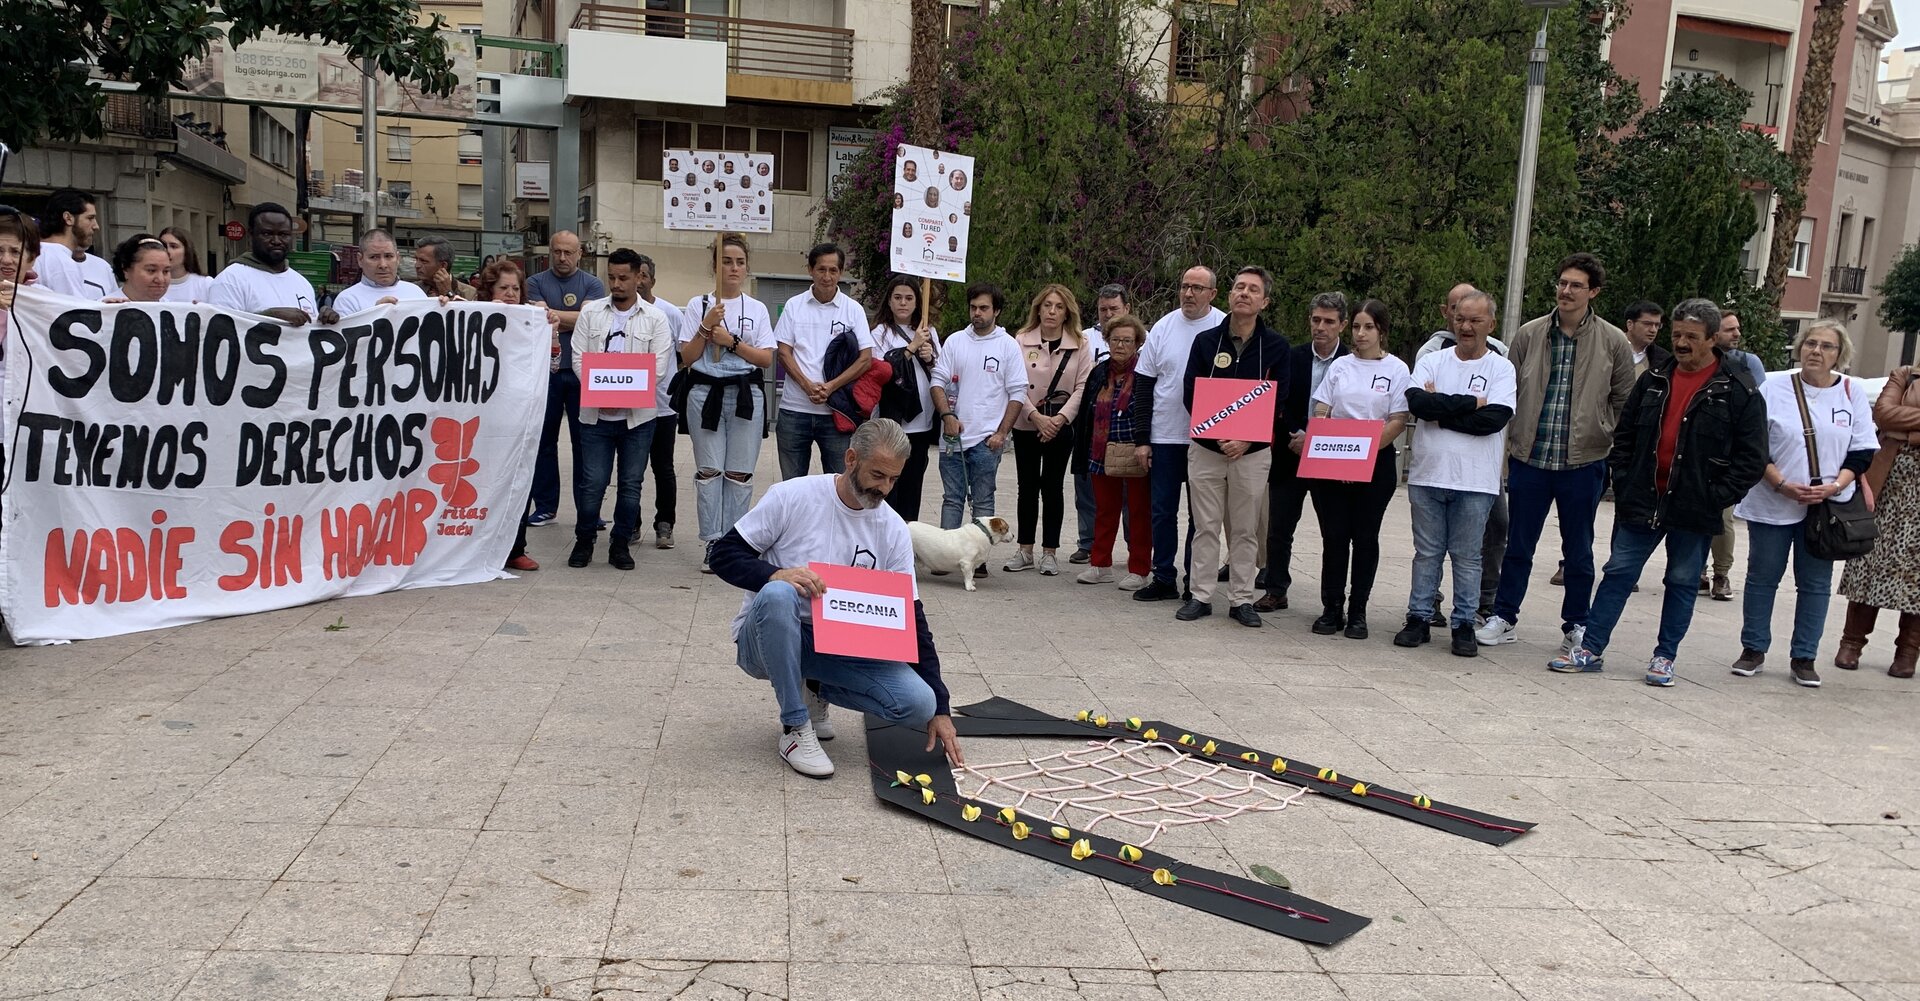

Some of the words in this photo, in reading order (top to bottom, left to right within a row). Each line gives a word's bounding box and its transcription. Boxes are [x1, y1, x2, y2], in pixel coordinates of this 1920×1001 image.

[234, 52, 257, 65] 688
[260, 54, 282, 67] 855
[284, 57, 307, 69] 260
[235, 65, 307, 79] lbg@solpriga.com
[917, 217, 944, 226] COMPARTE
[920, 223, 928, 231] TU
[48, 308, 287, 408] SOMOS
[308, 309, 507, 410] PERSONAS
[594, 375, 633, 384] SALUD
[18, 411, 208, 490] TENEMOS
[236, 413, 427, 487] DERECHOS
[1314, 443, 1361, 452] SONRISA
[829, 599, 898, 618] CERCANIA
